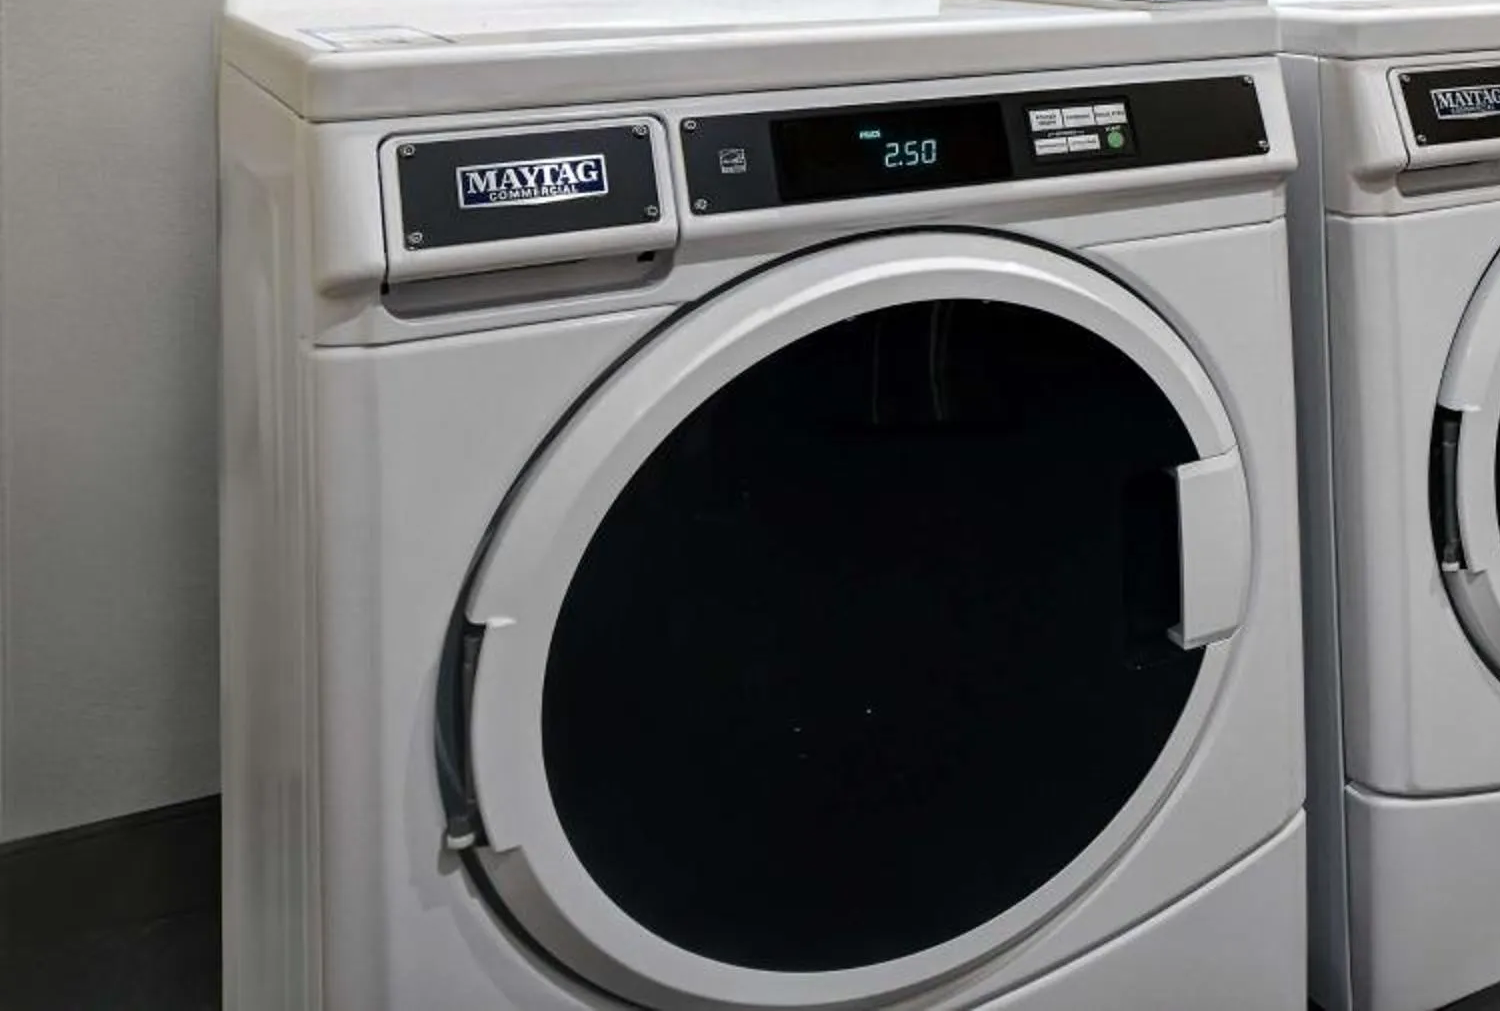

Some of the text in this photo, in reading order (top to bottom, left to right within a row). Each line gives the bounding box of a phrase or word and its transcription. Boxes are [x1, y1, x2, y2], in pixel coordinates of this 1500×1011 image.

[885, 139, 937, 167] 2.50
[465, 161, 599, 194] MAYTAG
[489, 184, 578, 201] COMMERCIAL
